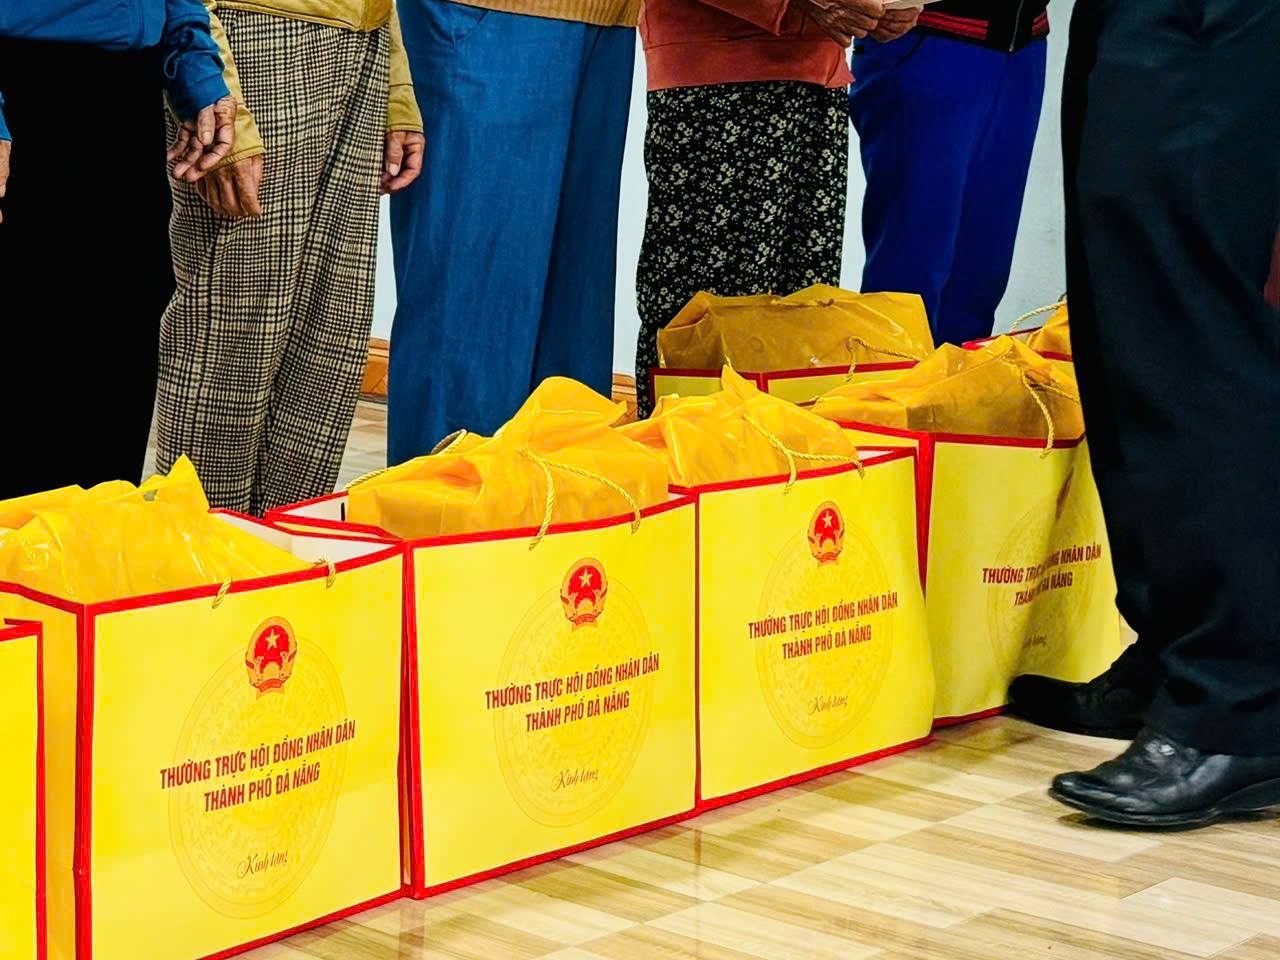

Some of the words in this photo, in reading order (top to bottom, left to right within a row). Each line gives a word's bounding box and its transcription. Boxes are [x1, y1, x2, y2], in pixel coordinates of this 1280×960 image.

[982, 565, 1024, 583] THƯỜNG
[485, 683, 531, 709] THƯỜNG
[535, 678, 562, 702] TRỰC
[566, 671, 583, 696] HỘI
[586, 664, 612, 689] ĐỒNG
[615, 658, 639, 682] NHÂN
[642, 652, 660, 674] DÂN
[160, 759, 211, 789] THƯỜNG
[215, 750, 246, 779] TRỰC
[250, 744, 270, 771] HỘI
[273, 735, 303, 764] ĐỒNG
[306, 727, 333, 753] NHÂN
[335, 719, 355, 744] DÂN
[204, 782, 245, 813] THÀNH
[249, 769, 273, 802] PHỐ
[276, 769, 290, 794] ĐÀ
[293, 760, 320, 788] NẴNG
